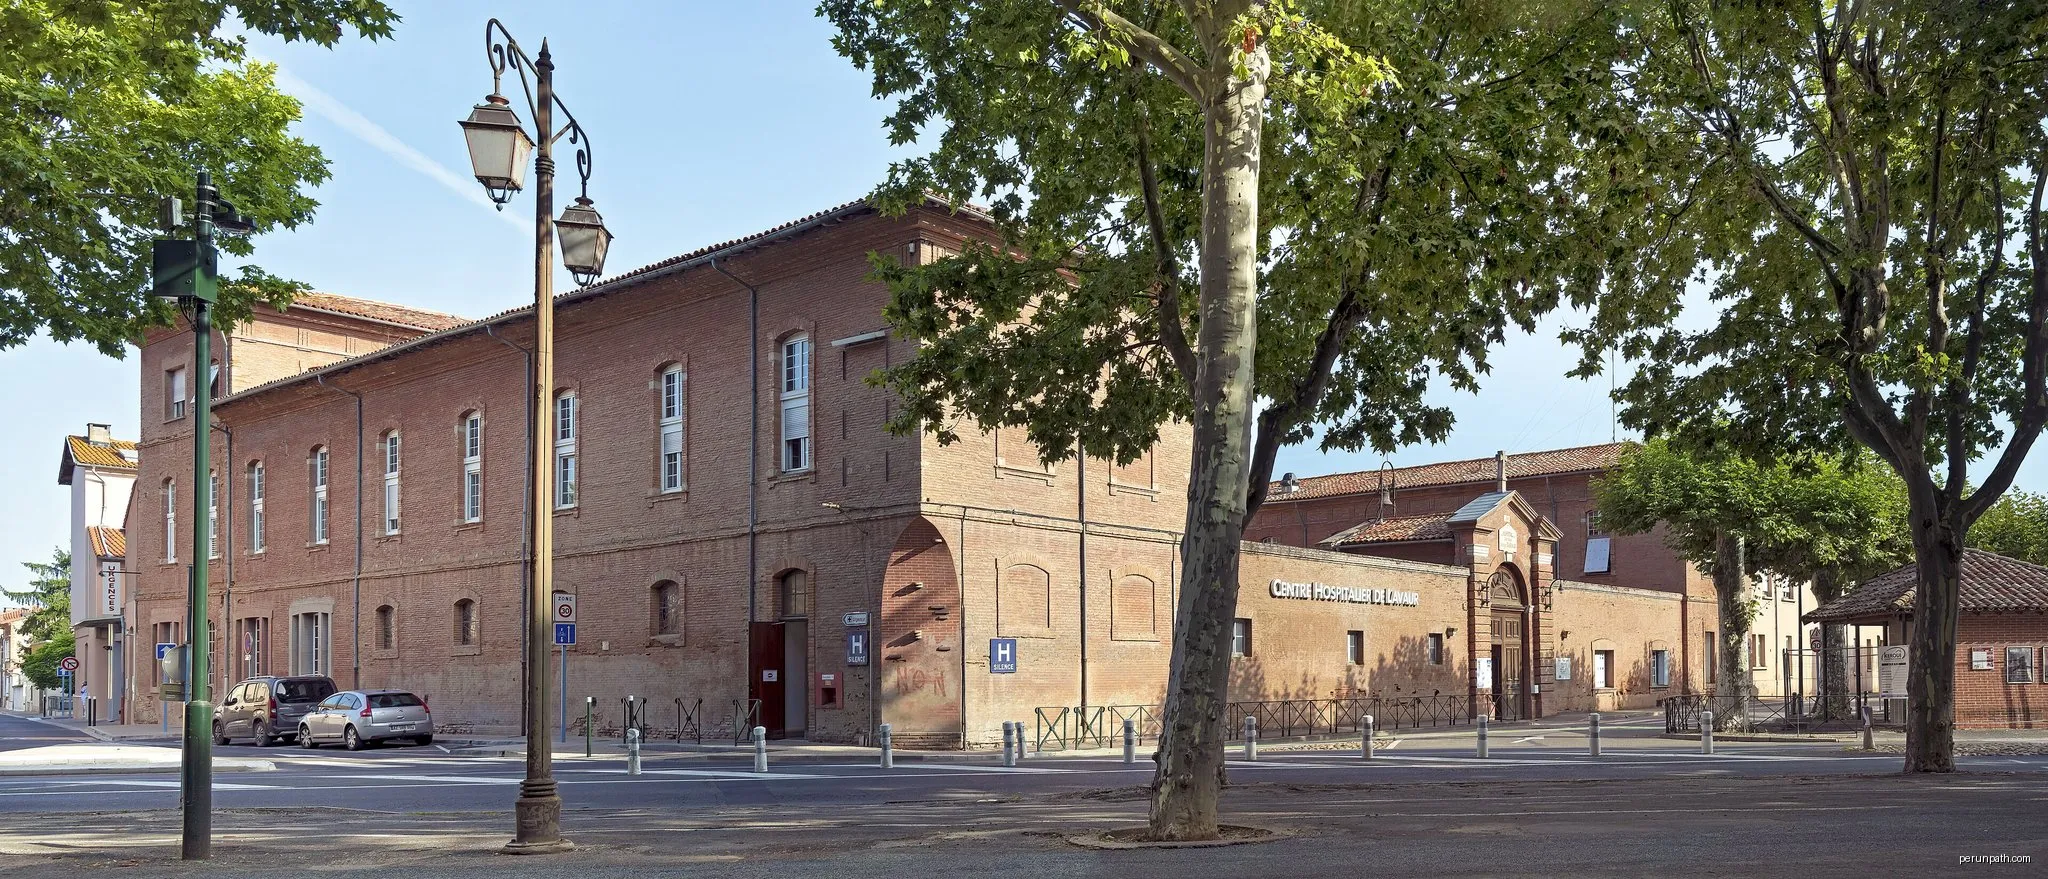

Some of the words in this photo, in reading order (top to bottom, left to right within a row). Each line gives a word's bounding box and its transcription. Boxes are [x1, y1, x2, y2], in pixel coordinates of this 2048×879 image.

[108, 565, 116, 612] URGENCES
[1272, 578, 1312, 598] CENTRE
[1314, 581, 1371, 602] HOSPITALIER
[1373, 589, 1385, 603] DE
[1385, 590, 1419, 605] LAVAUR
[561, 607, 570, 615] 30
[852, 634, 863, 654] H
[998, 643, 1010, 662] H
[848, 655, 866, 663] SILENCE
[993, 663, 1014, 671] SILENCE
